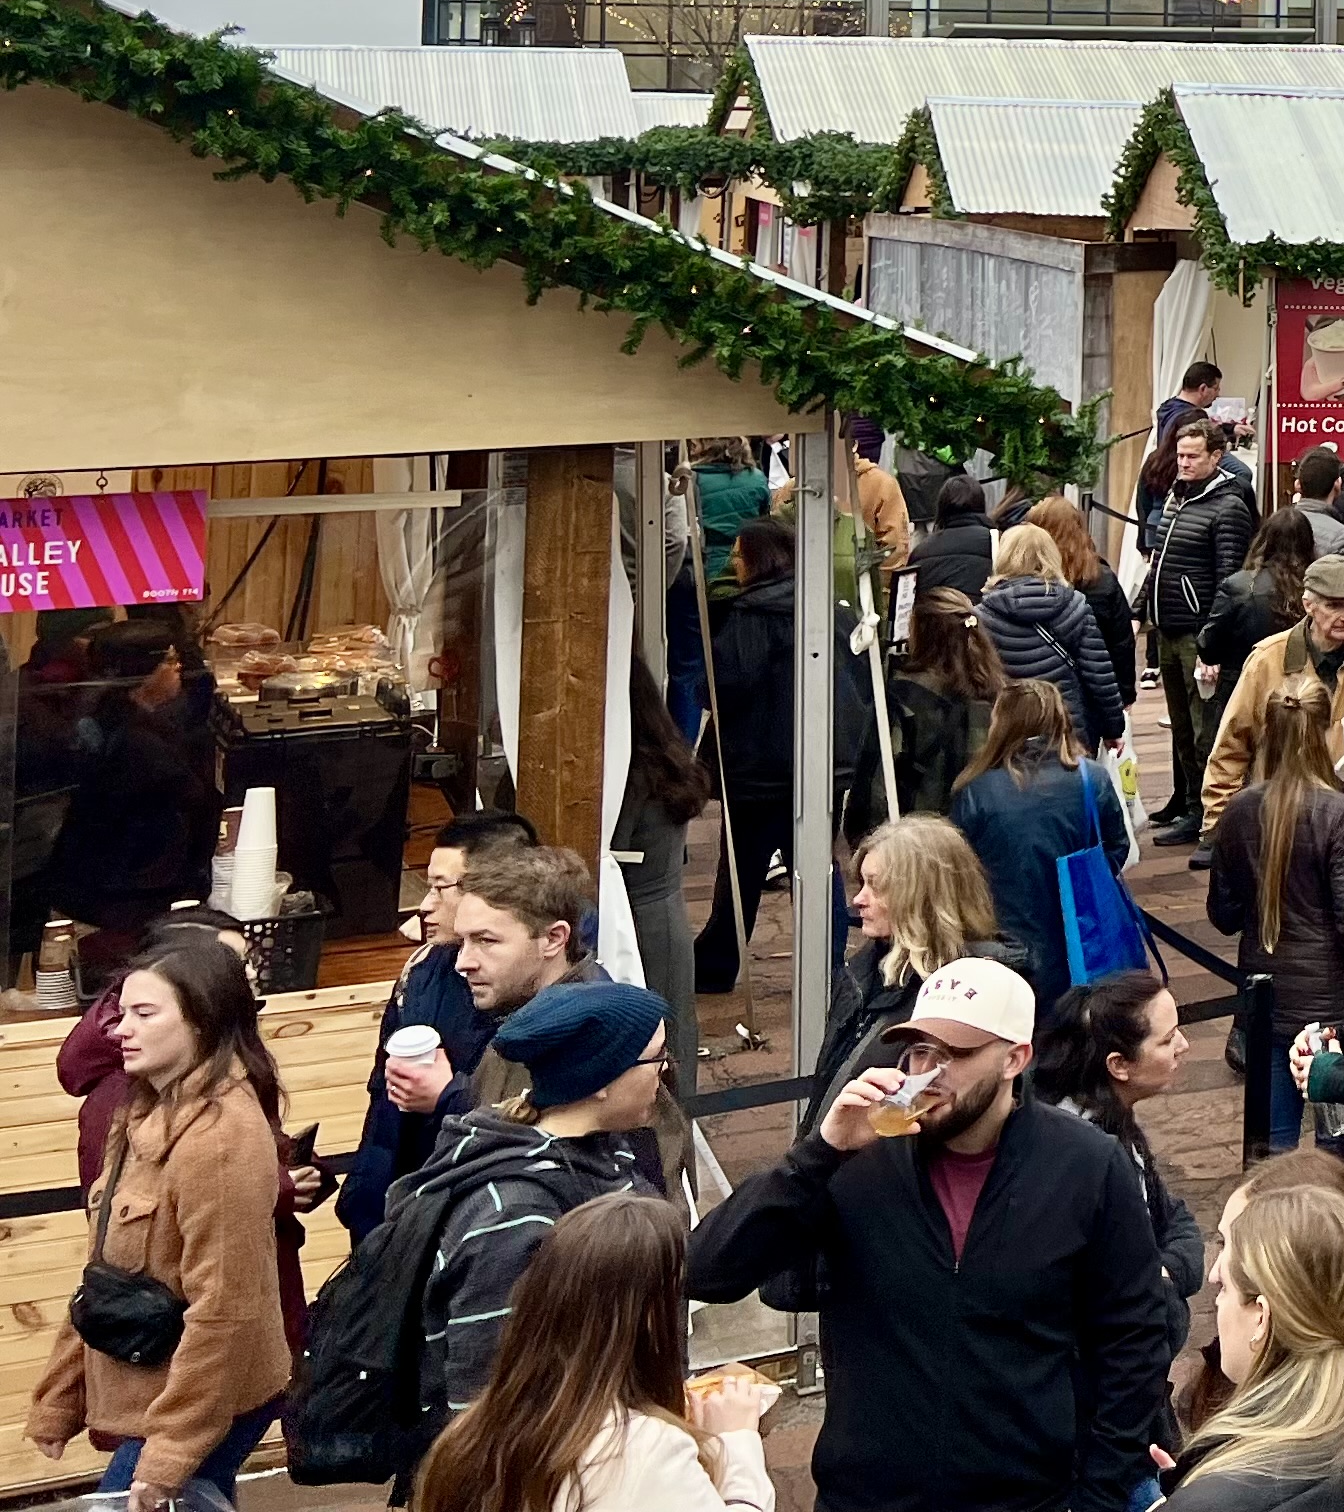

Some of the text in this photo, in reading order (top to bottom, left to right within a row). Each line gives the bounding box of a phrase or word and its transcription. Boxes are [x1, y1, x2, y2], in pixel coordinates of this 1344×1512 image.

[1281, 417, 1317, 433] Hot
[142, 588, 199, 598] BOOTH 114
